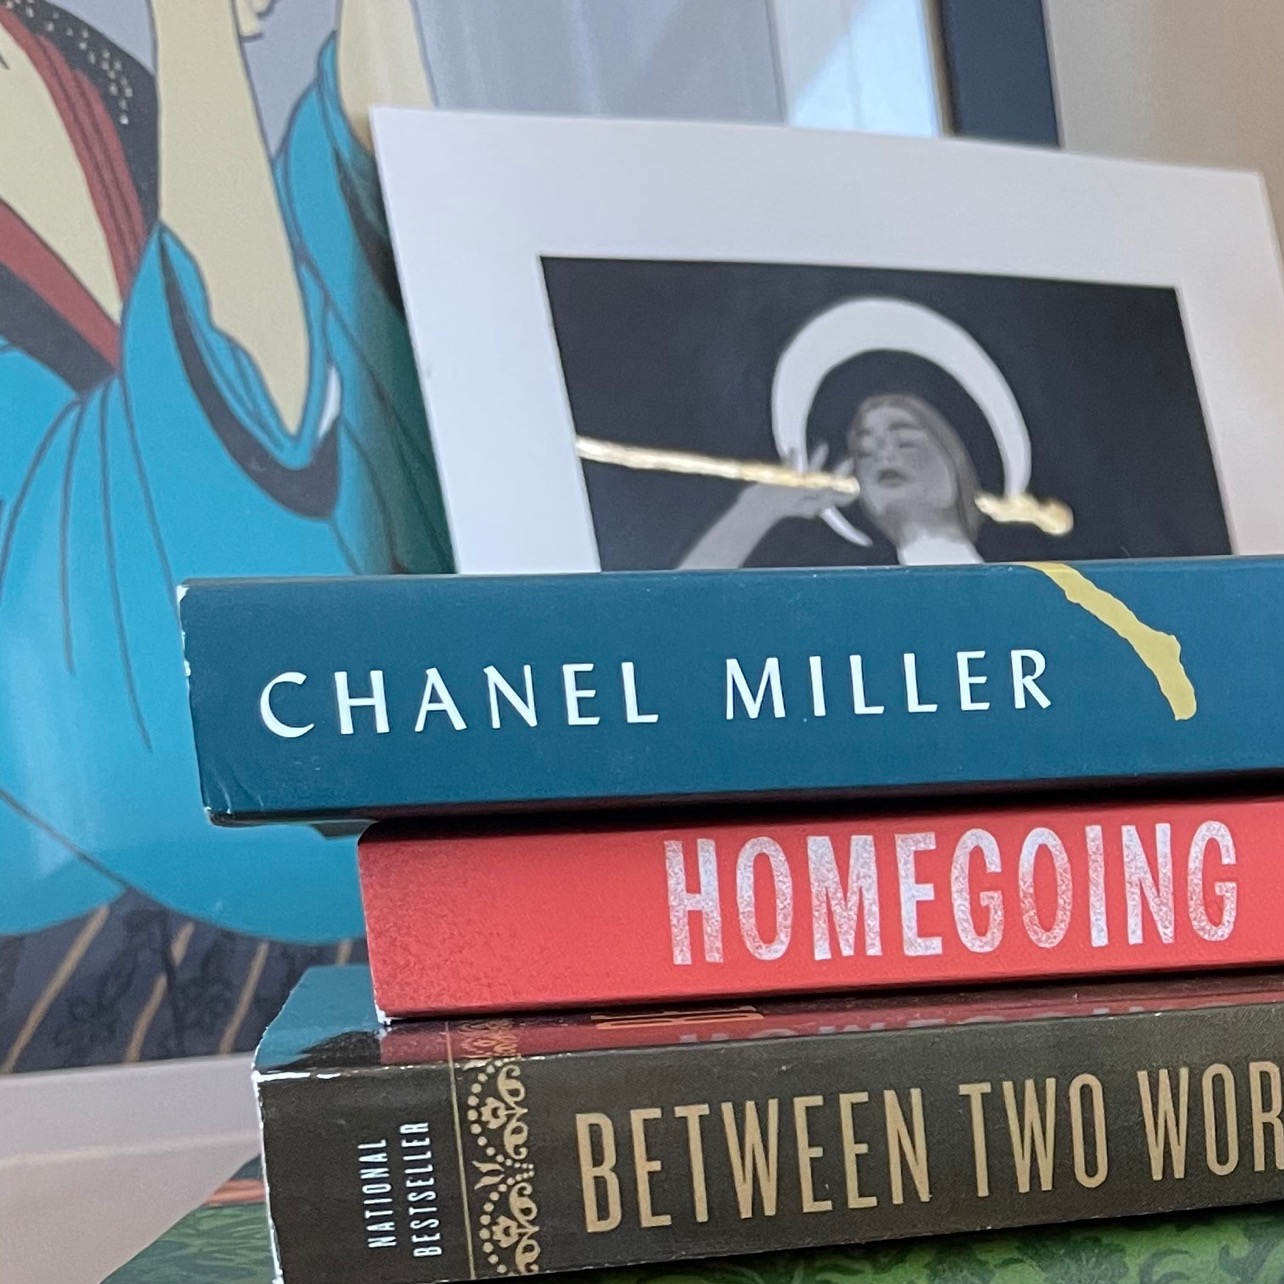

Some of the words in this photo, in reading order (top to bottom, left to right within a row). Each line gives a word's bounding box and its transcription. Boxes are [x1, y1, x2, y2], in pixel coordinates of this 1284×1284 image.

[259, 661, 659, 738] CHANEL
[725, 648, 1052, 720] MILLER
[664, 820, 1238, 966] HOMEGOING
[357, 1139, 397, 1248] NATIONAL
[400, 1122, 442, 1257] BESTSELLER
[575, 1087, 932, 1233] BETWEEN
[958, 1072, 1108, 1197] TWO
